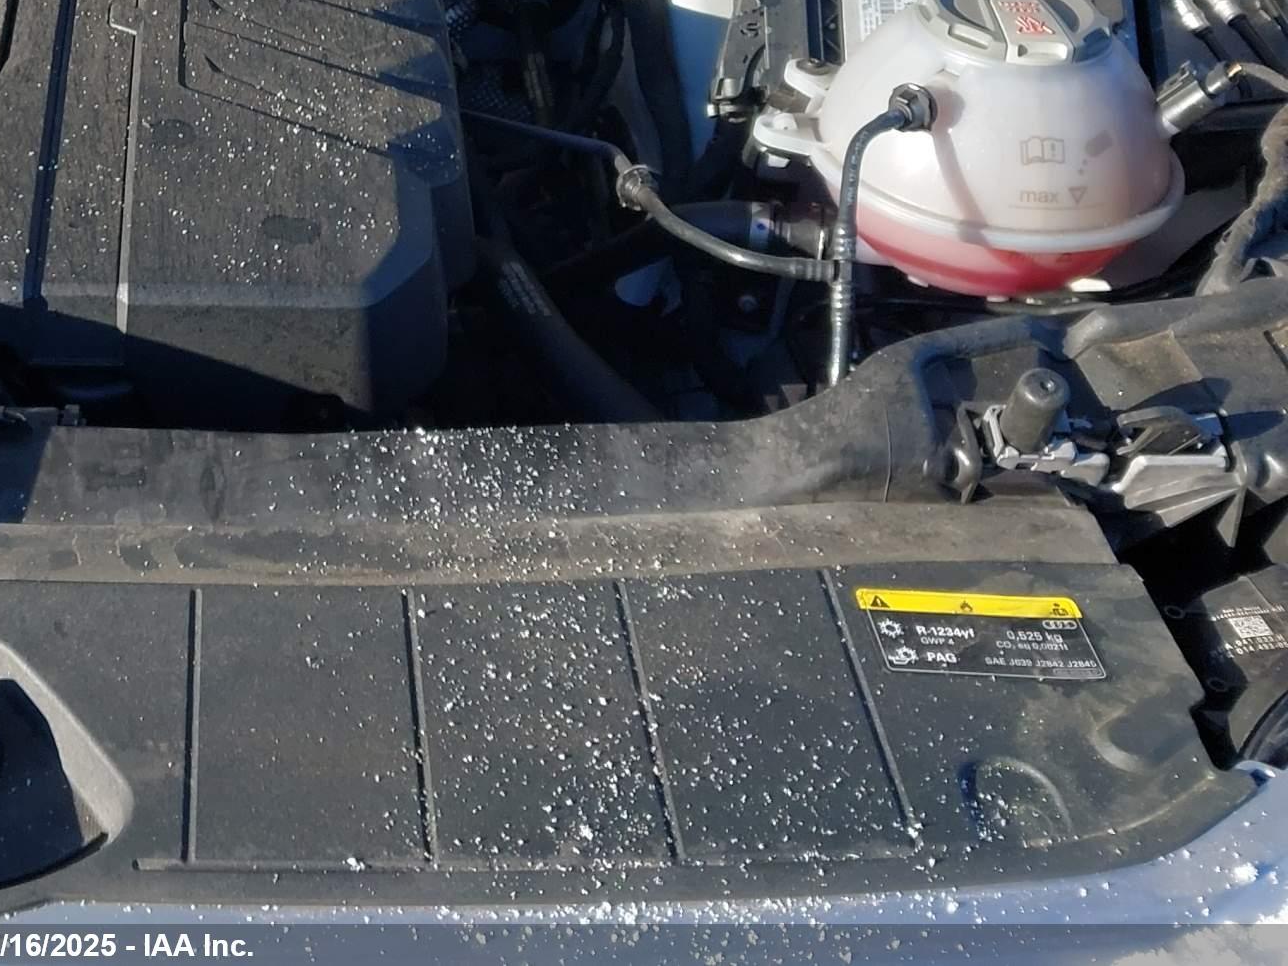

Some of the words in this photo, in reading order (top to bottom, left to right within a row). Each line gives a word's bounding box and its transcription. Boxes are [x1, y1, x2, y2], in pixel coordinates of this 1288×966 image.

[1019, 189, 1059, 203] max
[915, 625, 975, 640] R-1234yf
[1006, 630, 1043, 642] 0,525
[1044, 631, 1063, 644] kg
[926, 651, 957, 664] PAG
[985, 656, 1006, 666] SAE
